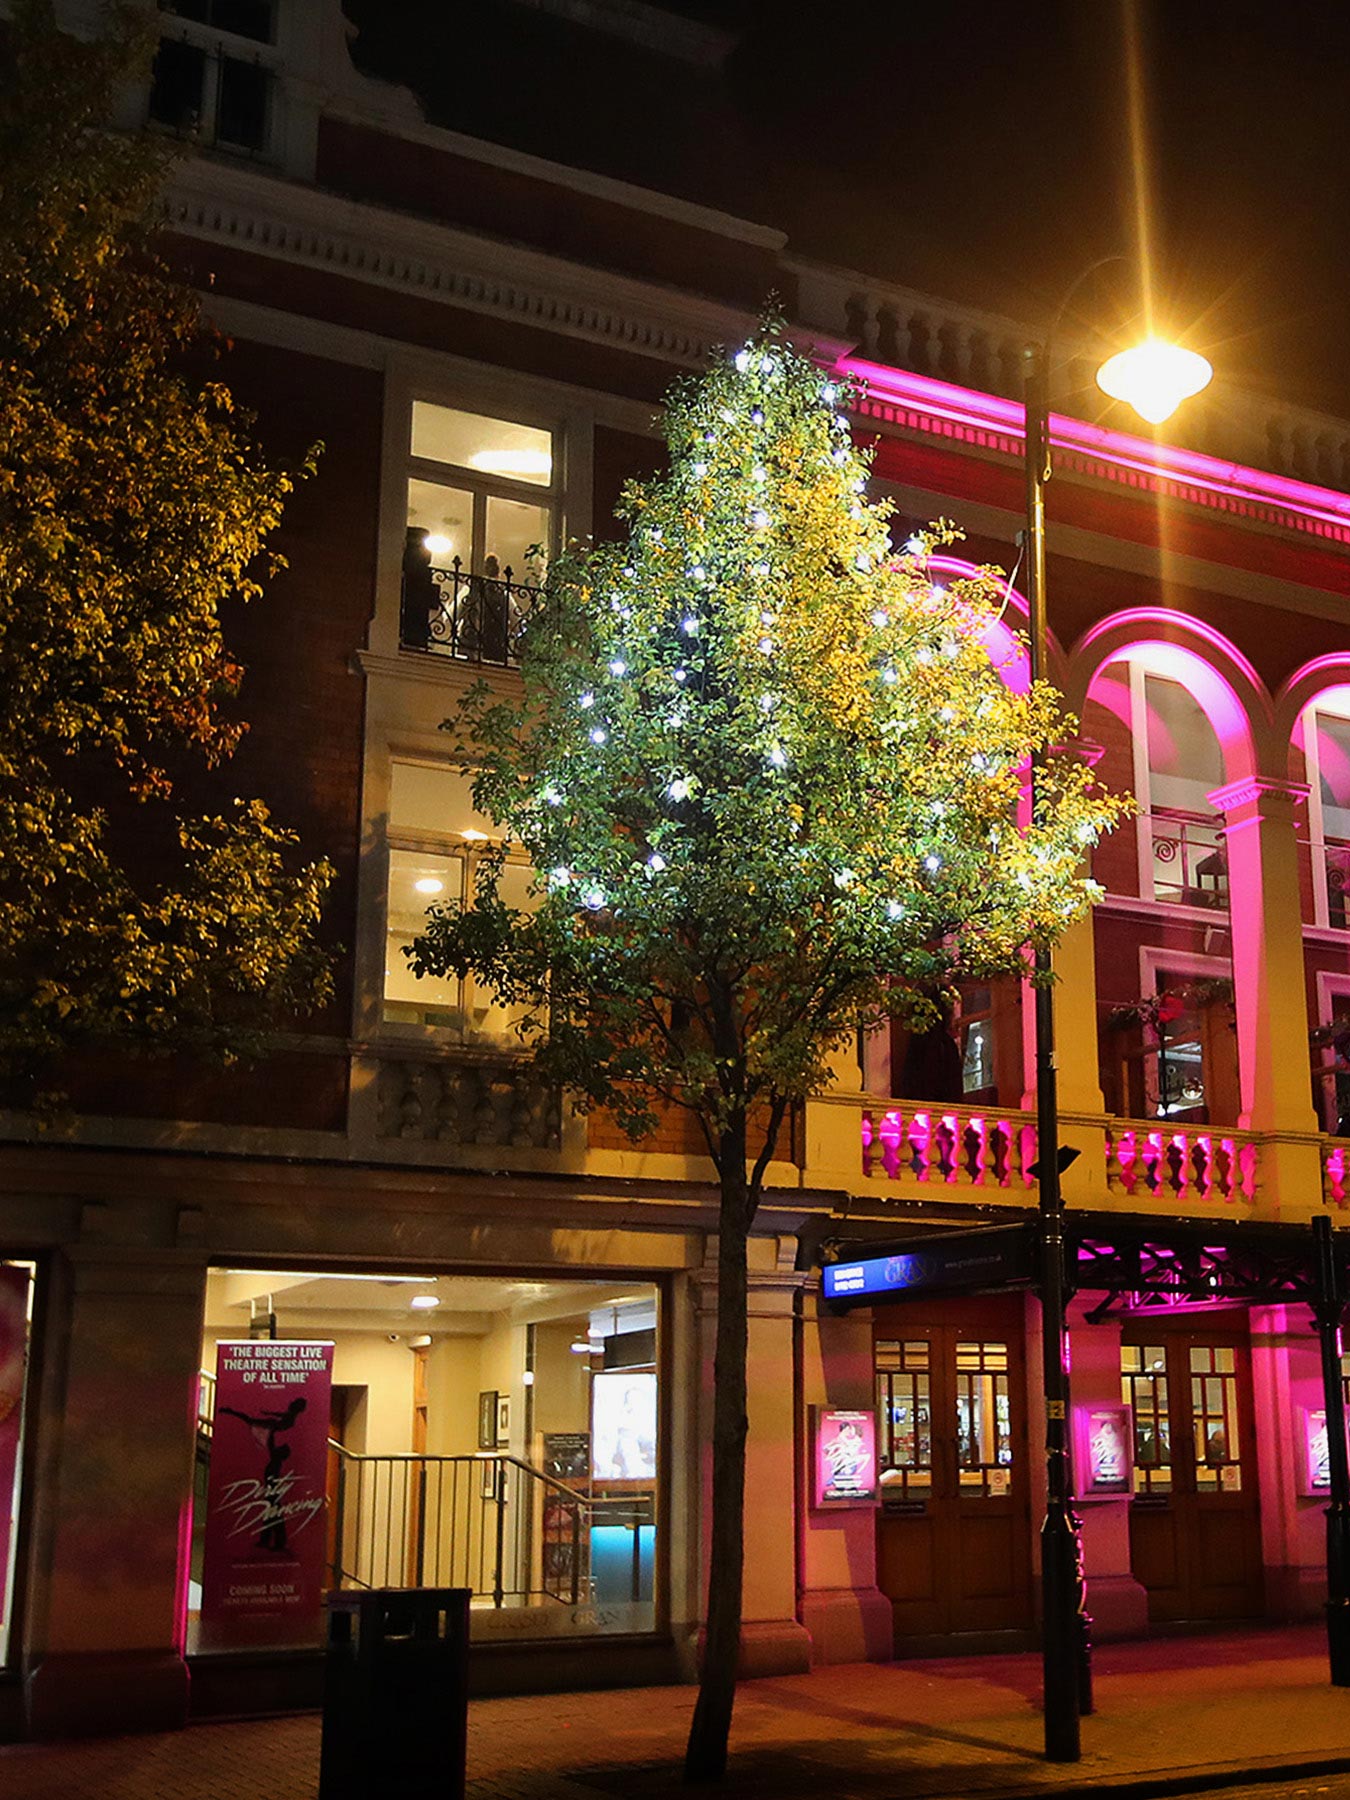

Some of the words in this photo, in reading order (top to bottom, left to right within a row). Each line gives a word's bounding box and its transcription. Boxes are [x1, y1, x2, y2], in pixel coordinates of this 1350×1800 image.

[255, 1347, 297, 1358] BIGGEST
[300, 1347, 323, 1358] LIVE
[223, 1359, 269, 1370] THEATRE
[271, 1359, 327, 1371] SENSATION
[243, 1372, 257, 1383] OF
[259, 1372, 278, 1383] ALL
[215, 1470, 306, 1512] Dirty
[226, 1489, 323, 1538] Dancing
